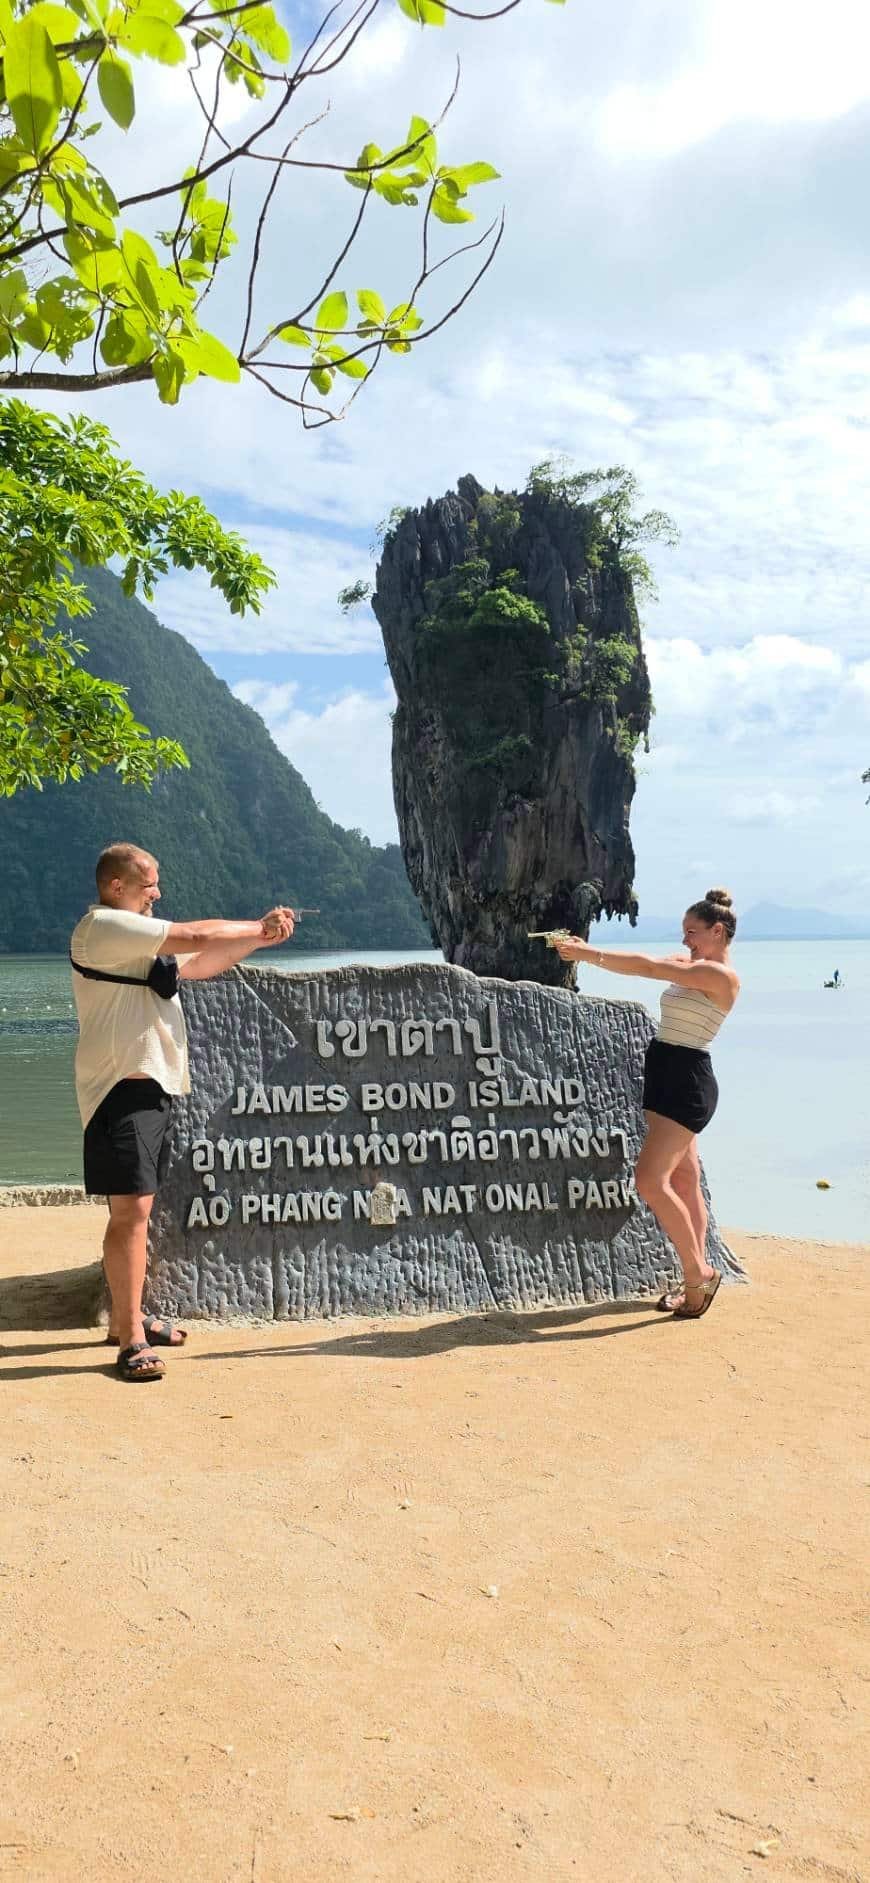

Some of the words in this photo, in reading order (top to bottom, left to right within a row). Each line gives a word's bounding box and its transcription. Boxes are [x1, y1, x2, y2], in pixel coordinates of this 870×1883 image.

[316, 1003, 499, 1077] เขาตาปู
[231, 1085, 348, 1115] JAMES
[361, 1082, 455, 1112] BOND
[470, 1078, 585, 1108] ISLAND
[192, 1111, 629, 1191] อุทยานแห่งชาติอ่าวพังงา
[187, 1197, 230, 1228] AO
[242, 1192, 342, 1223] PHANG
[353, 1188, 413, 1219] NA
[422, 1182, 559, 1215] NATONAL
[568, 1179, 640, 1209] PARK
